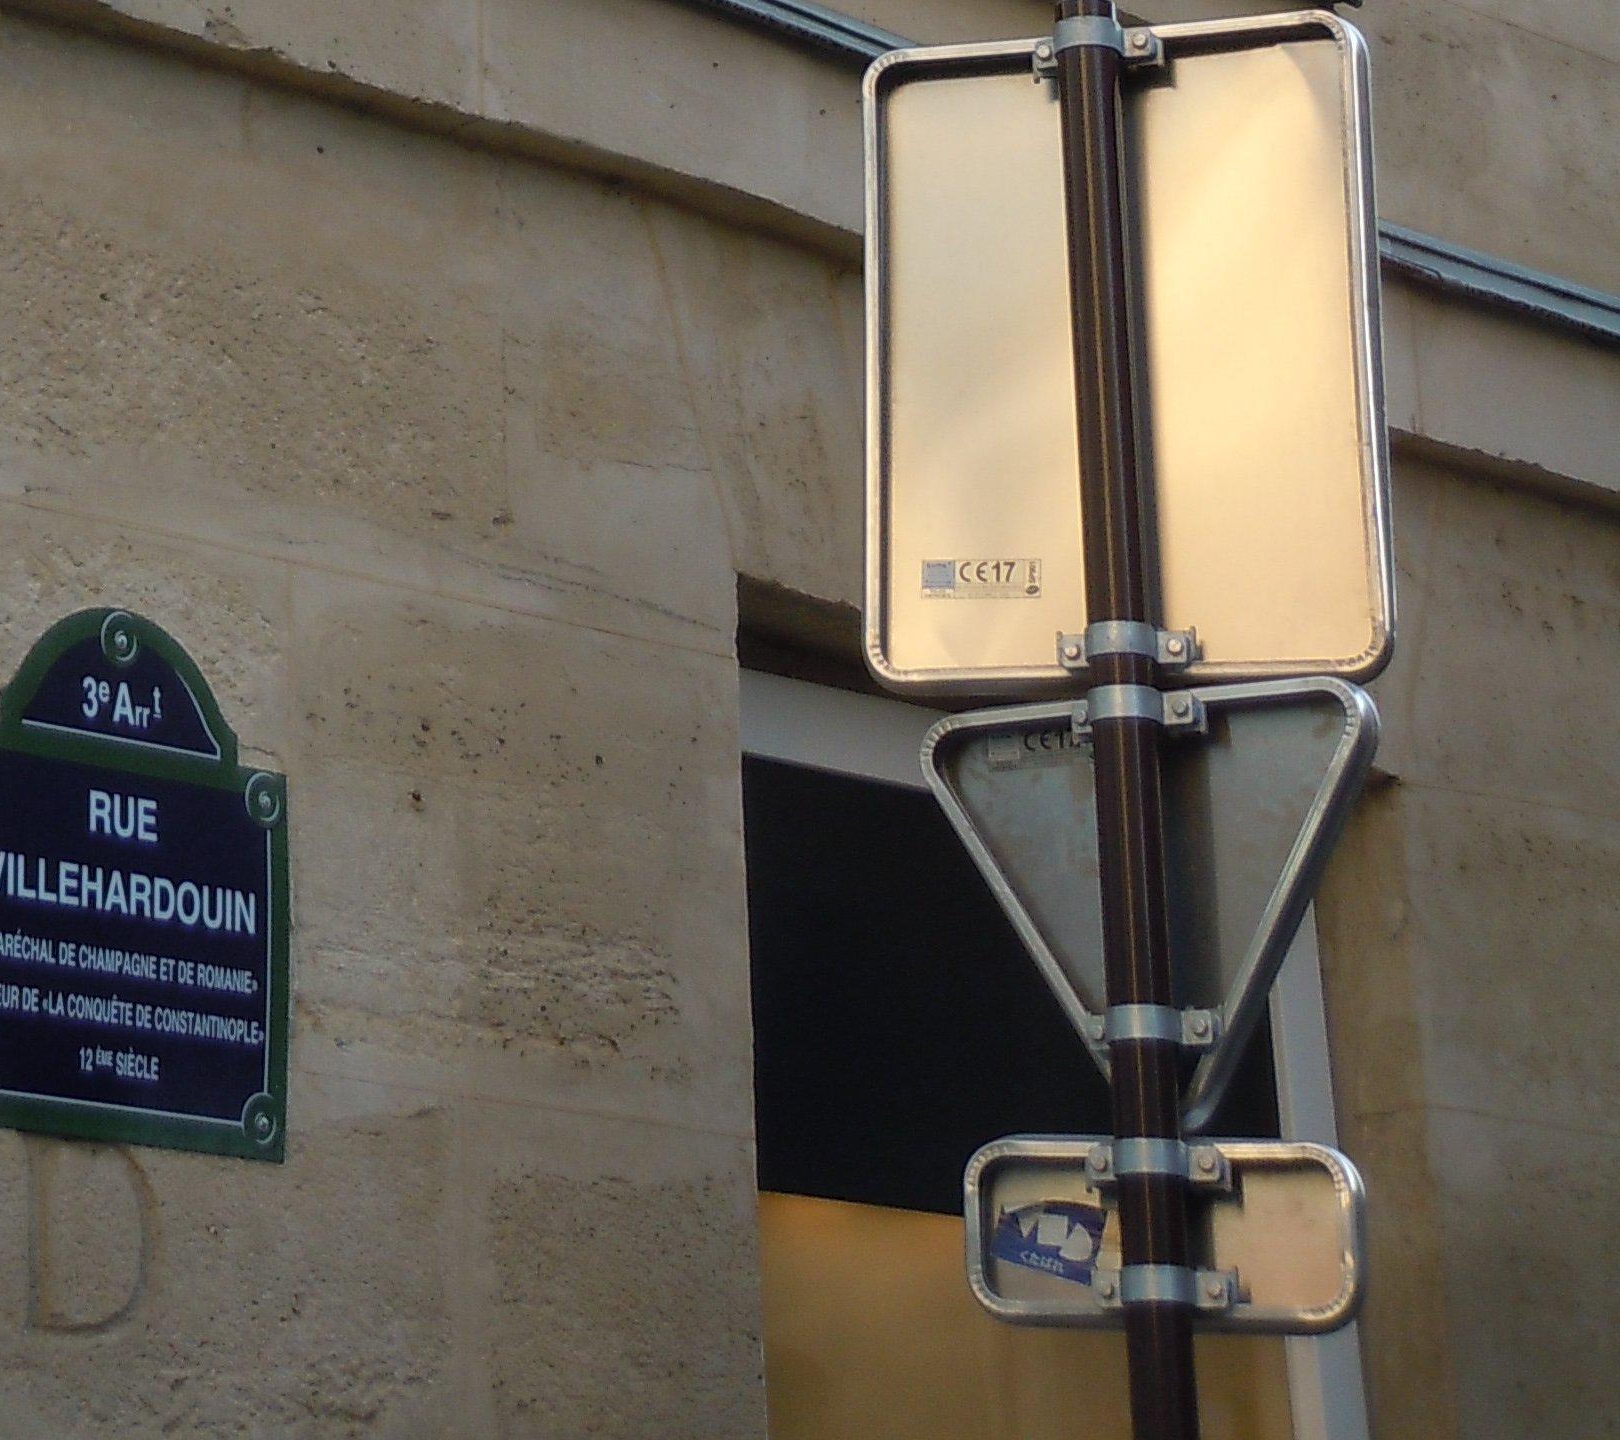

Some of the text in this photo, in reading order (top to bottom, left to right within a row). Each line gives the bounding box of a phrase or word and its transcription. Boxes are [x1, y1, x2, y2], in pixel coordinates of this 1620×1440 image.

[82, 676, 110, 718] 3e
[89, 790, 159, 843] RUE
[59, 943, 76, 967] DE
[79, 947, 157, 980] CHAMPAGNE
[160, 957, 175, 981] ET
[178, 960, 194, 984] DE
[197, 964, 258, 993] ROMANIE»
[22, 988, 39, 1011] DE
[42, 992, 64, 1016] «LA
[67, 993, 132, 1024] CONQUÊTE
[136, 1004, 152, 1028] DE
[155, 1007, 264, 1045] CONSTANTINOPLE»
[116, 1046, 159, 1081] SIÈCLE
